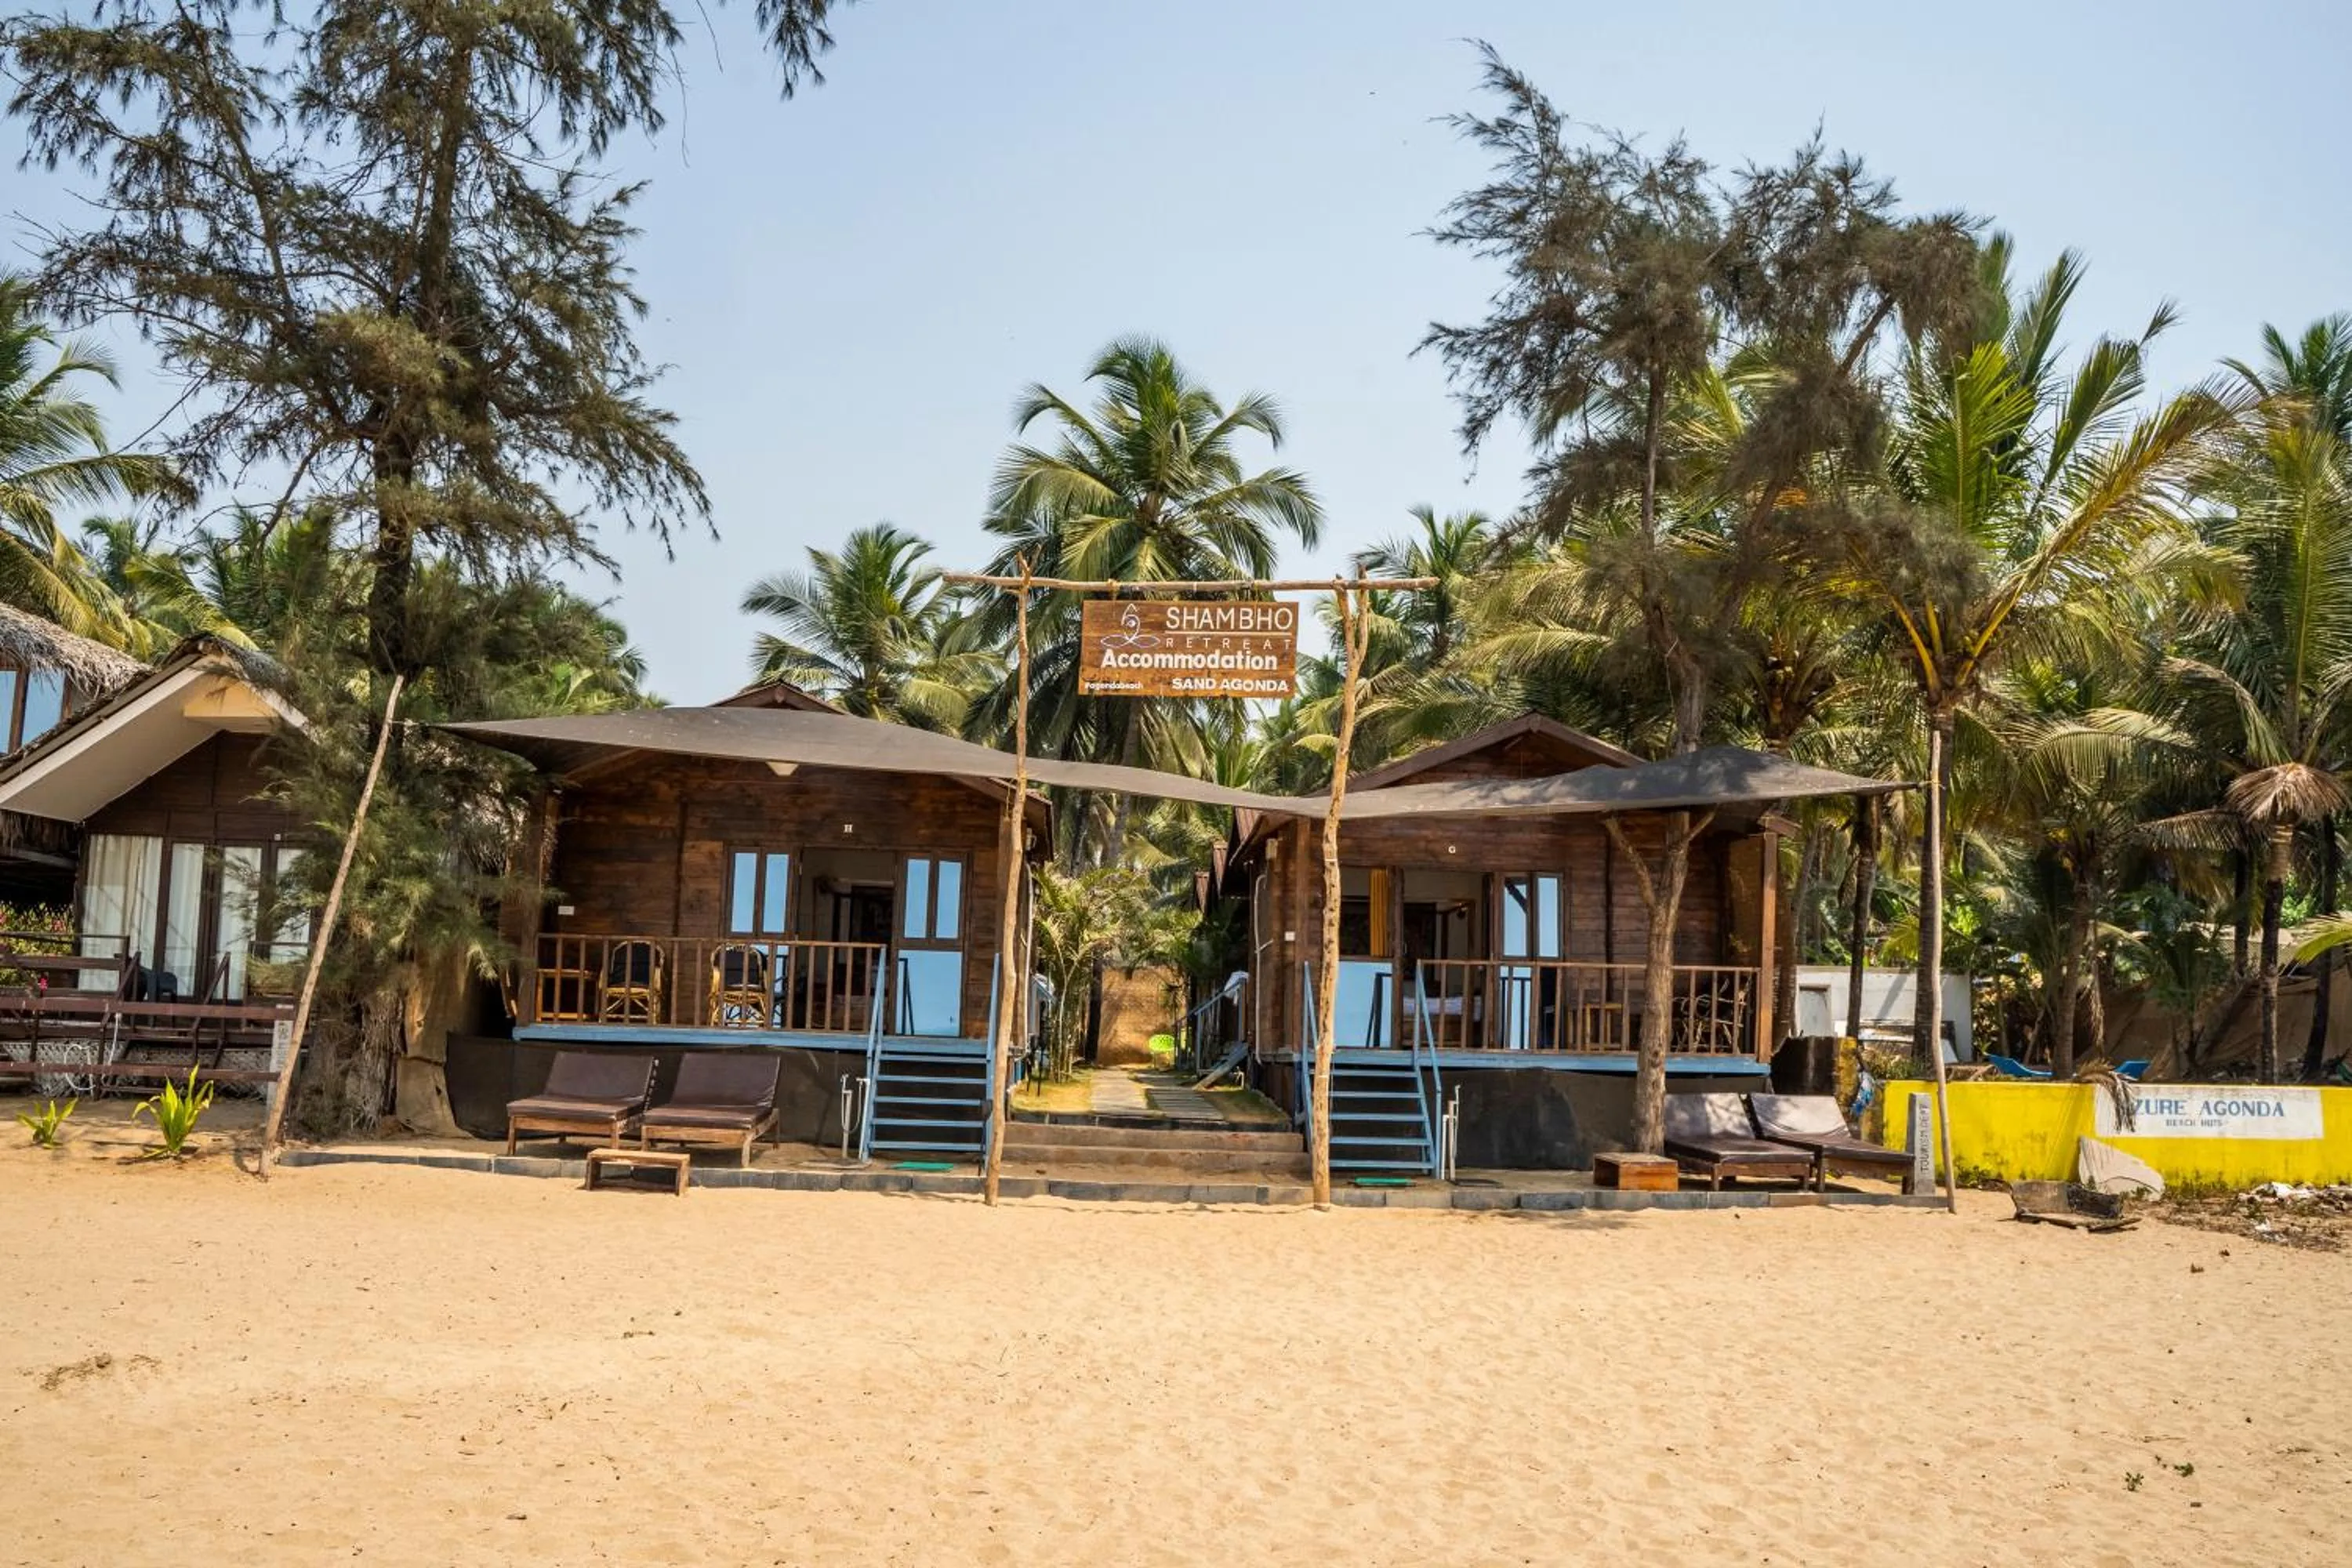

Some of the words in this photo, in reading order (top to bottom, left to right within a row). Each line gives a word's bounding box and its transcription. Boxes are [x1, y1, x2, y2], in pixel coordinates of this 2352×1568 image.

[1166, 606, 1293, 630] SHAMBHO
[1166, 637, 1290, 650] RETREAT
[1101, 648, 1277, 670] Accommodation
[1172, 678, 1215, 690] SAND
[1220, 679, 1289, 691] AGONDA
[2129, 1099, 2187, 1115] ZURE
[2199, 1101, 2285, 1116] AGONDA
